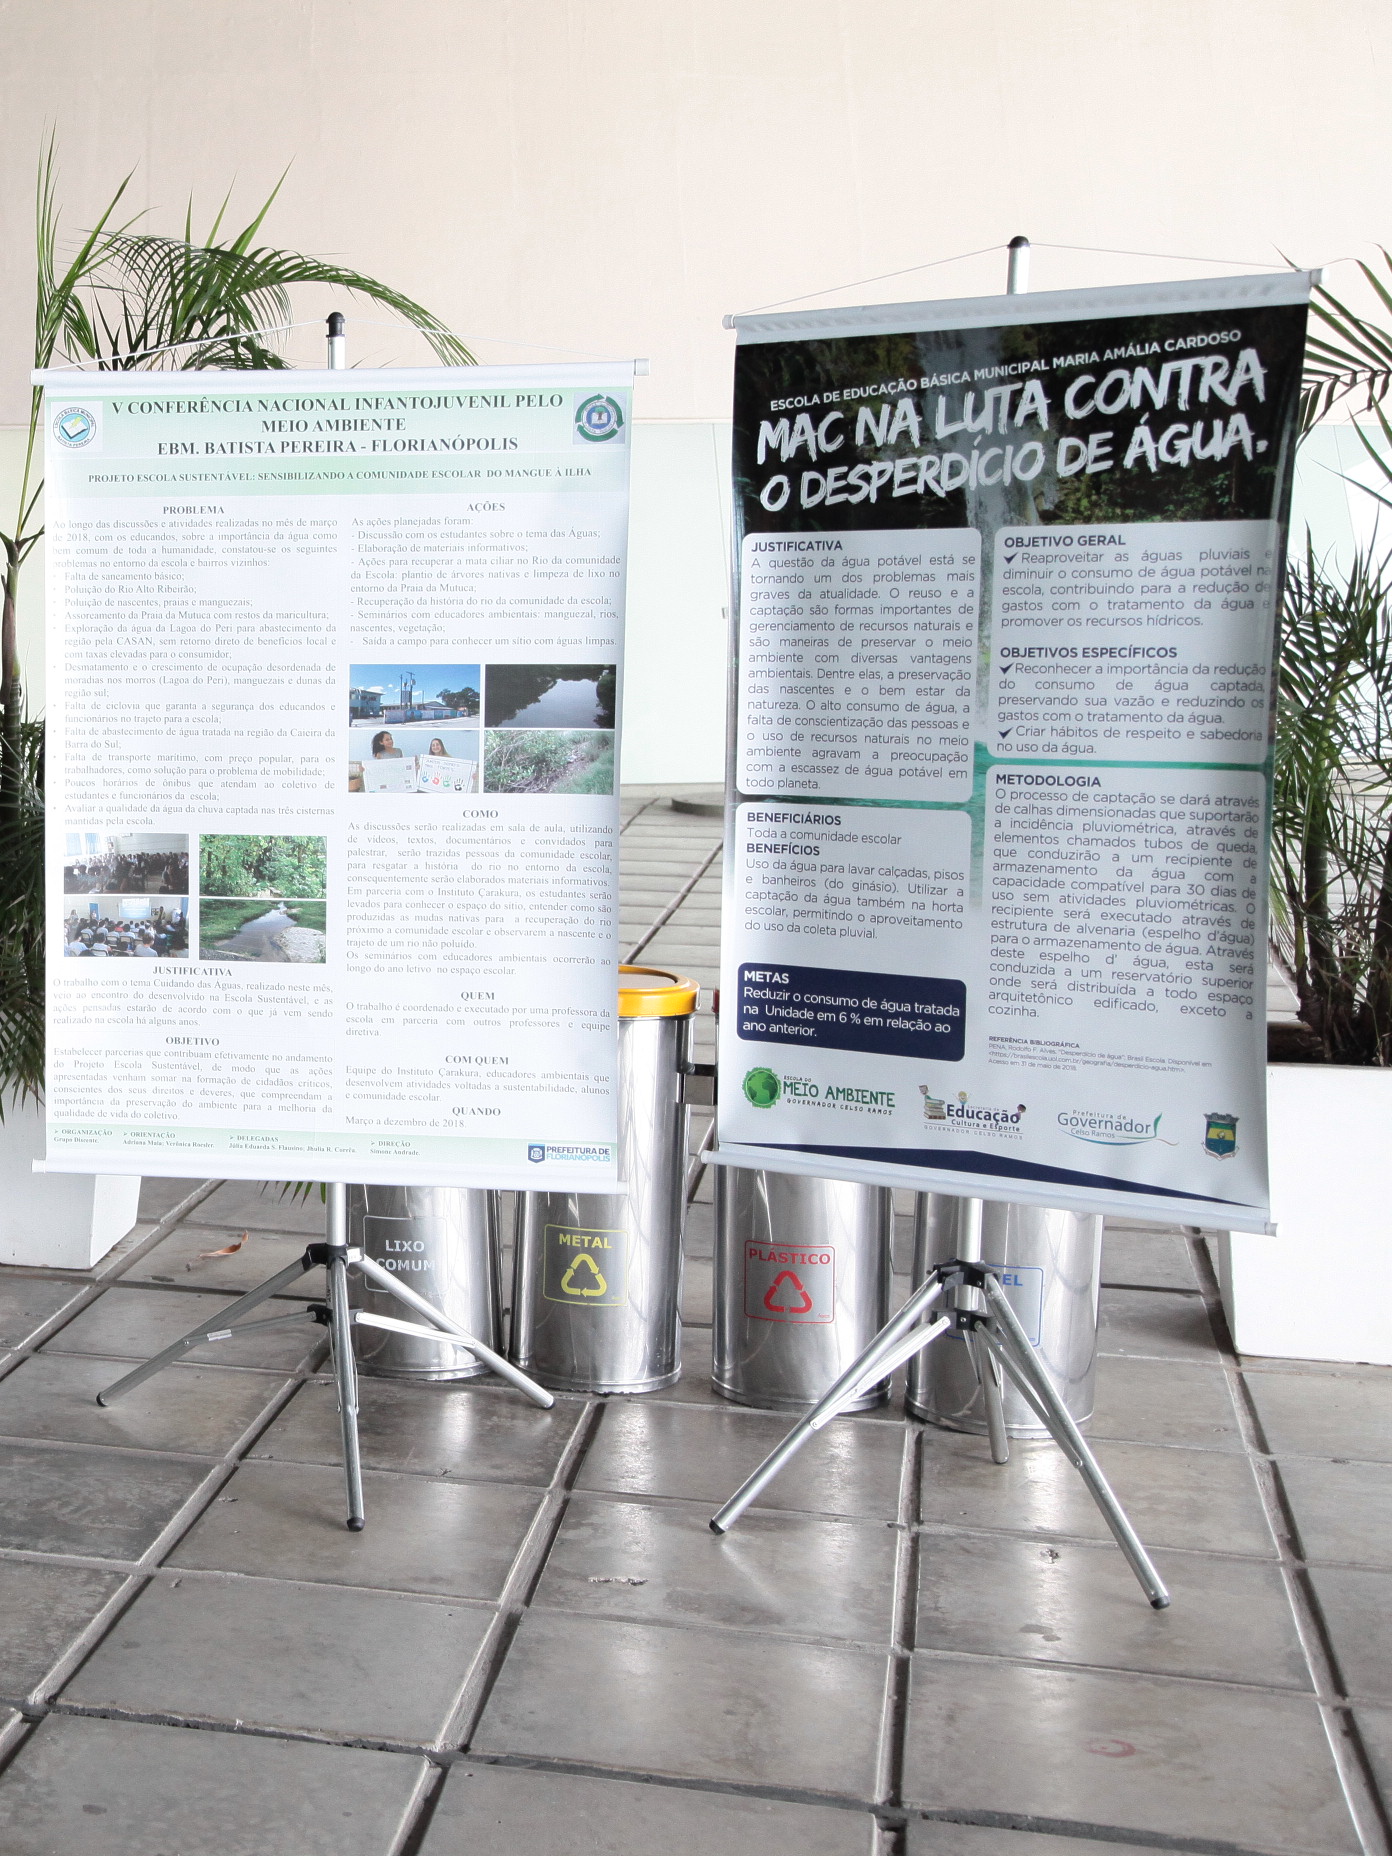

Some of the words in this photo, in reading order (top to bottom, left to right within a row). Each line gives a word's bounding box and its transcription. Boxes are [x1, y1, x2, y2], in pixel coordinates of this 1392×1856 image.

[770, 394, 820, 412] ESCOLA
[823, 391, 840, 402] DE
[843, 377, 917, 400] EDUCAÇÃO
[920, 372, 971, 389] BÁSICA
[973, 358, 1049, 381] MUNICIPAL
[1053, 351, 1100, 368] MARIA
[1103, 341, 1161, 361] AMÁLIA
[1164, 329, 1242, 352] CARDOSO
[112, 401, 123, 414] V
[127, 396, 253, 414] CONFERÊNCIA
[257, 398, 351, 413] NACIONAL
[355, 395, 511, 411] INFANTOJUVENIL
[515, 393, 563, 408] PELO
[756, 410, 844, 465] MAC
[855, 397, 922, 448] NA
[934, 379, 1051, 440] LUTA
[1064, 349, 1267, 420] CONTRA
[262, 419, 308, 432] MEIO
[312, 418, 405, 431] AMBIENTE
[157, 441, 199, 456] EBM.
[204, 441, 276, 455] BATISTA
[280, 440, 357, 453] PEREIRA
[371, 434, 518, 452] FLORIANÓPOLIS
[759, 474, 791, 512] O
[800, 440, 1046, 509] DESPERDÍCIO
[1056, 431, 1113, 478] DE
[1122, 412, 1268, 472] ÁGUA.
[87, 474, 134, 483] PROJETO
[137, 473, 177, 482] ESCOLA
[179, 471, 256, 482] SUSTENTÁVEL:
[258, 472, 346, 481] SENSIBILIZANDO
[356, 470, 429, 480] COMUNIDADE
[431, 469, 481, 479] ESCOLAR
[486, 469, 502, 478] DO
[504, 468, 552, 478] MANGUE
[565, 468, 592, 477] ILHA
[163, 505, 224, 514] PROBLEMA
[466, 500, 505, 513] AÇÕES
[751, 540, 842, 552] JUSTIFICATIVA
[1004, 535, 1073, 548] OBJETIVO
[1077, 534, 1126, 546] GERAL
[1000, 646, 1078, 658] OBJETIVOS
[1082, 645, 1177, 658] ESPECÍFICOS
[996, 773, 1101, 787] METODOLOGIA
[462, 809, 498, 818] COMO
[747, 812, 841, 826] BENEFICIÁRIOS
[746, 842, 820, 856] BENEFÍCIOS
[153, 966, 232, 976] JUSTIFICATIVA
[744, 970, 789, 984] METAS
[460, 991, 494, 1001] QUEM
[743, 986, 790, 1001] Reduzir
[803, 993, 859, 1007] consumo
[861, 996, 877, 1009] de
[880, 998, 911, 1012] água
[914, 1002, 959, 1016] tratada
[743, 1005, 759, 1015] na
[765, 1004, 814, 1020] Unidade
[816, 1011, 836, 1022] em
[863, 1016, 883, 1026] em
[886, 1016, 931, 1031] relação
[934, 1023, 951, 1033] ao
[742, 1021, 766, 1031] ano
[768, 1023, 817, 1037] anterior.
[165, 1036, 219, 1045] OBJETIVO
[445, 1055, 472, 1065] COM
[474, 1055, 509, 1065] QUEM
[783, 1081, 819, 1097] MEIO
[825, 1085, 895, 1109] AMBIENTE
[452, 1106, 501, 1116] QUANDO
[787, 1098, 837, 1109] GOVERNADOR
[840, 1103, 864, 1113] CELSO
[868, 1108, 893, 1117] RAMOS
[946, 1103, 1020, 1126] Educação
[1057, 1112, 1151, 1134] Governador
[546, 1145, 597, 1155] PREFEITURA
[598, 1147, 610, 1155] DE
[385, 1239, 425, 1252] LIXO
[559, 1233, 613, 1249] METAL
[749, 1245, 831, 1265] PLÁSTICO
[376, 1258, 435, 1271] COMUM
